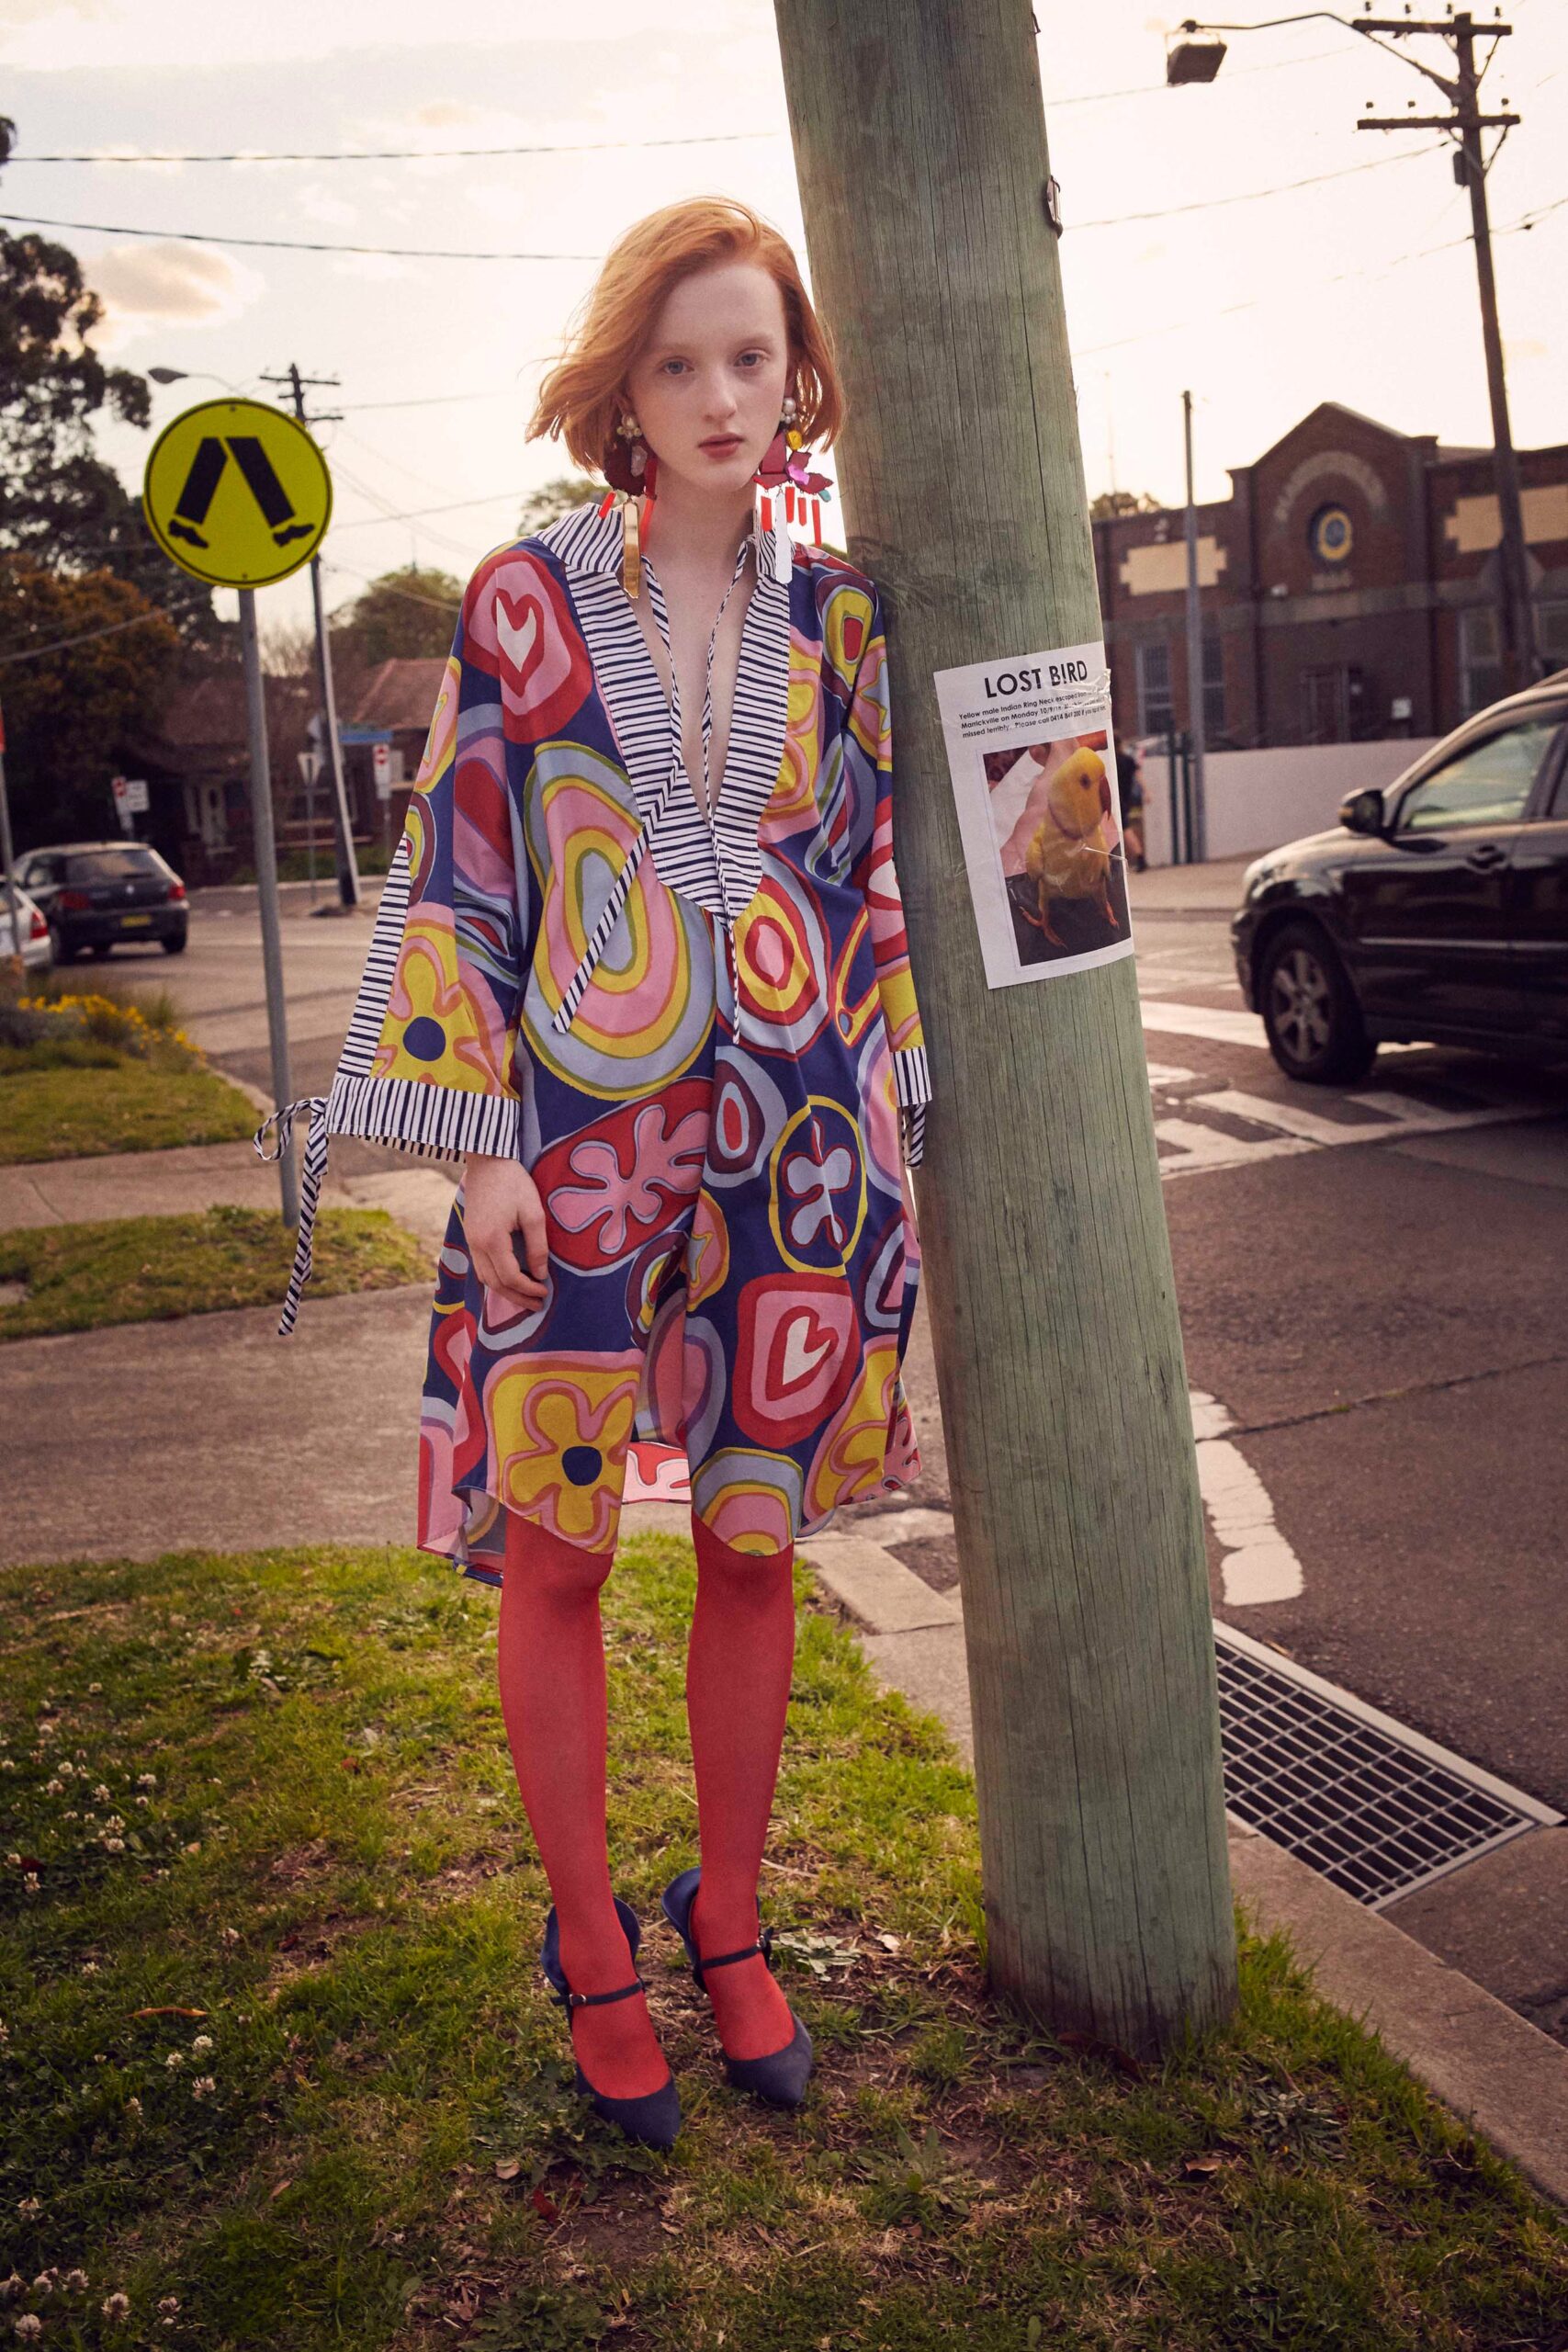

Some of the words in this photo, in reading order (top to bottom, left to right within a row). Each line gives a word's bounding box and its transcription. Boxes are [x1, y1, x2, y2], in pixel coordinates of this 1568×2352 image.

[985, 668, 1042, 698] LOST
[1048, 660, 1088, 687] BIRD
[959, 712, 981, 720] Yellow
[982, 707, 999, 716] male
[1001, 704, 1022, 712] Indian
[1055, 693, 1077, 702] escaped
[961, 717, 999, 729] Marrickville
[1011, 710, 1038, 720] Monday
[962, 729, 985, 738] missed
